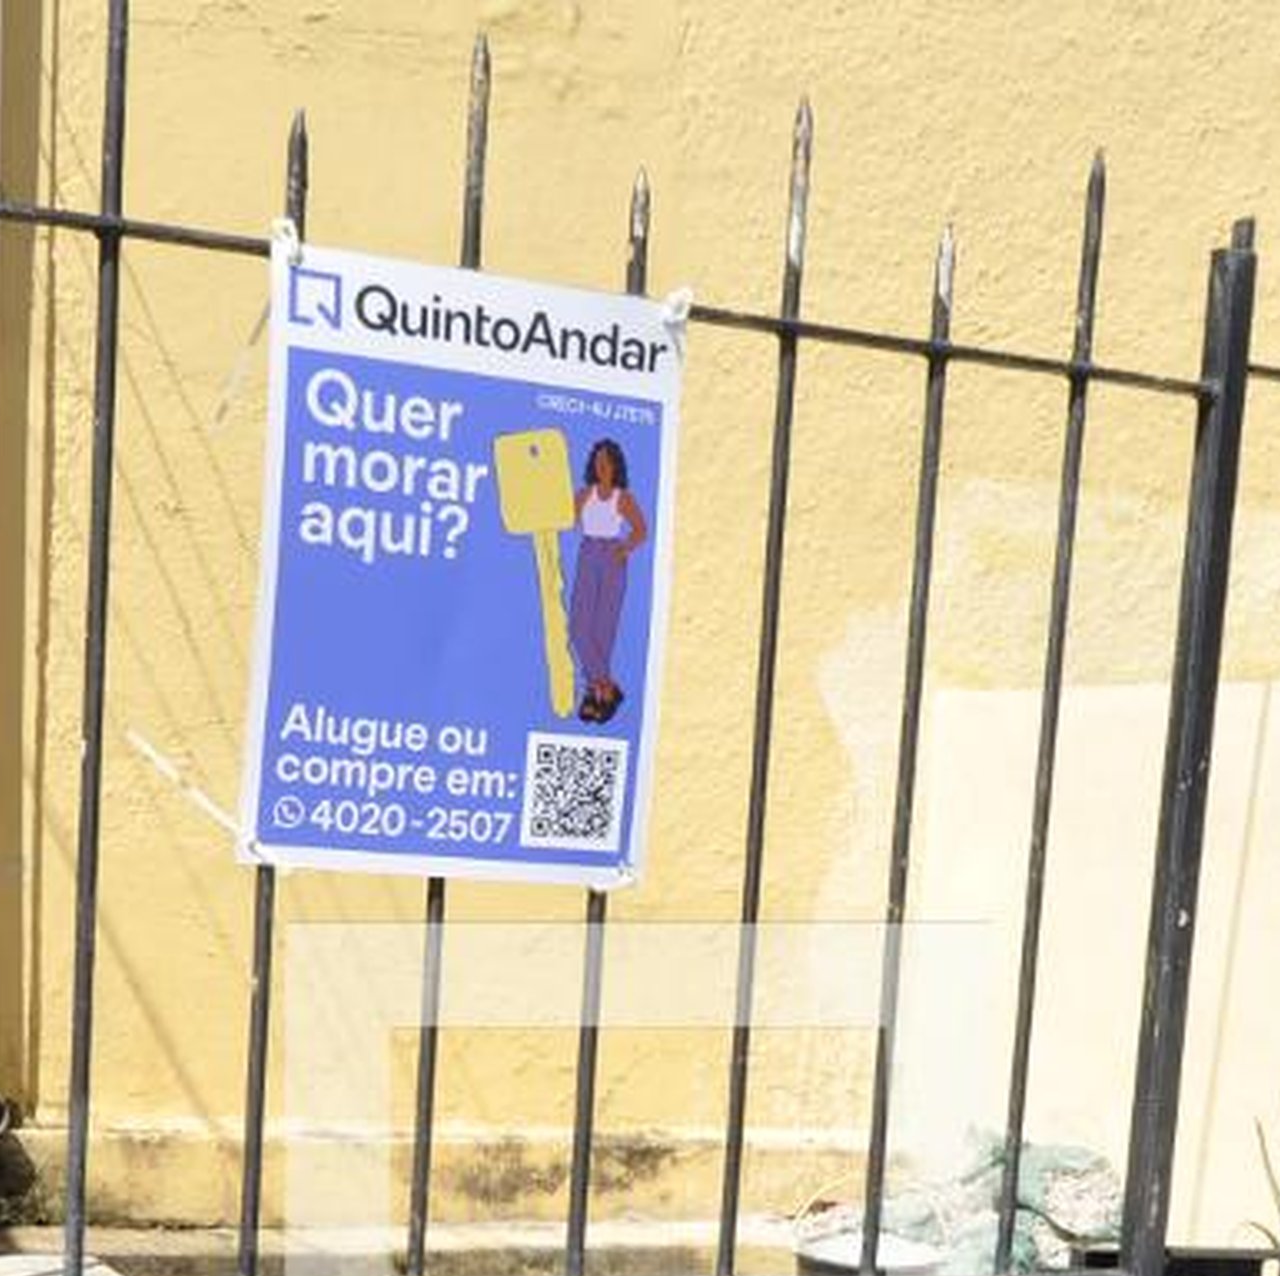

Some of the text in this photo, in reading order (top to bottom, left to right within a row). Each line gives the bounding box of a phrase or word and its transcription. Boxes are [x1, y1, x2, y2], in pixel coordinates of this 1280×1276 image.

[354, 284, 668, 373] QuintoAndar
[305, 368, 463, 441] Quer
[301, 439, 489, 504] morar
[299, 500, 469, 566] aqui?
[279, 702, 488, 756] Alugue ou
[275, 754, 518, 799] compre em:
